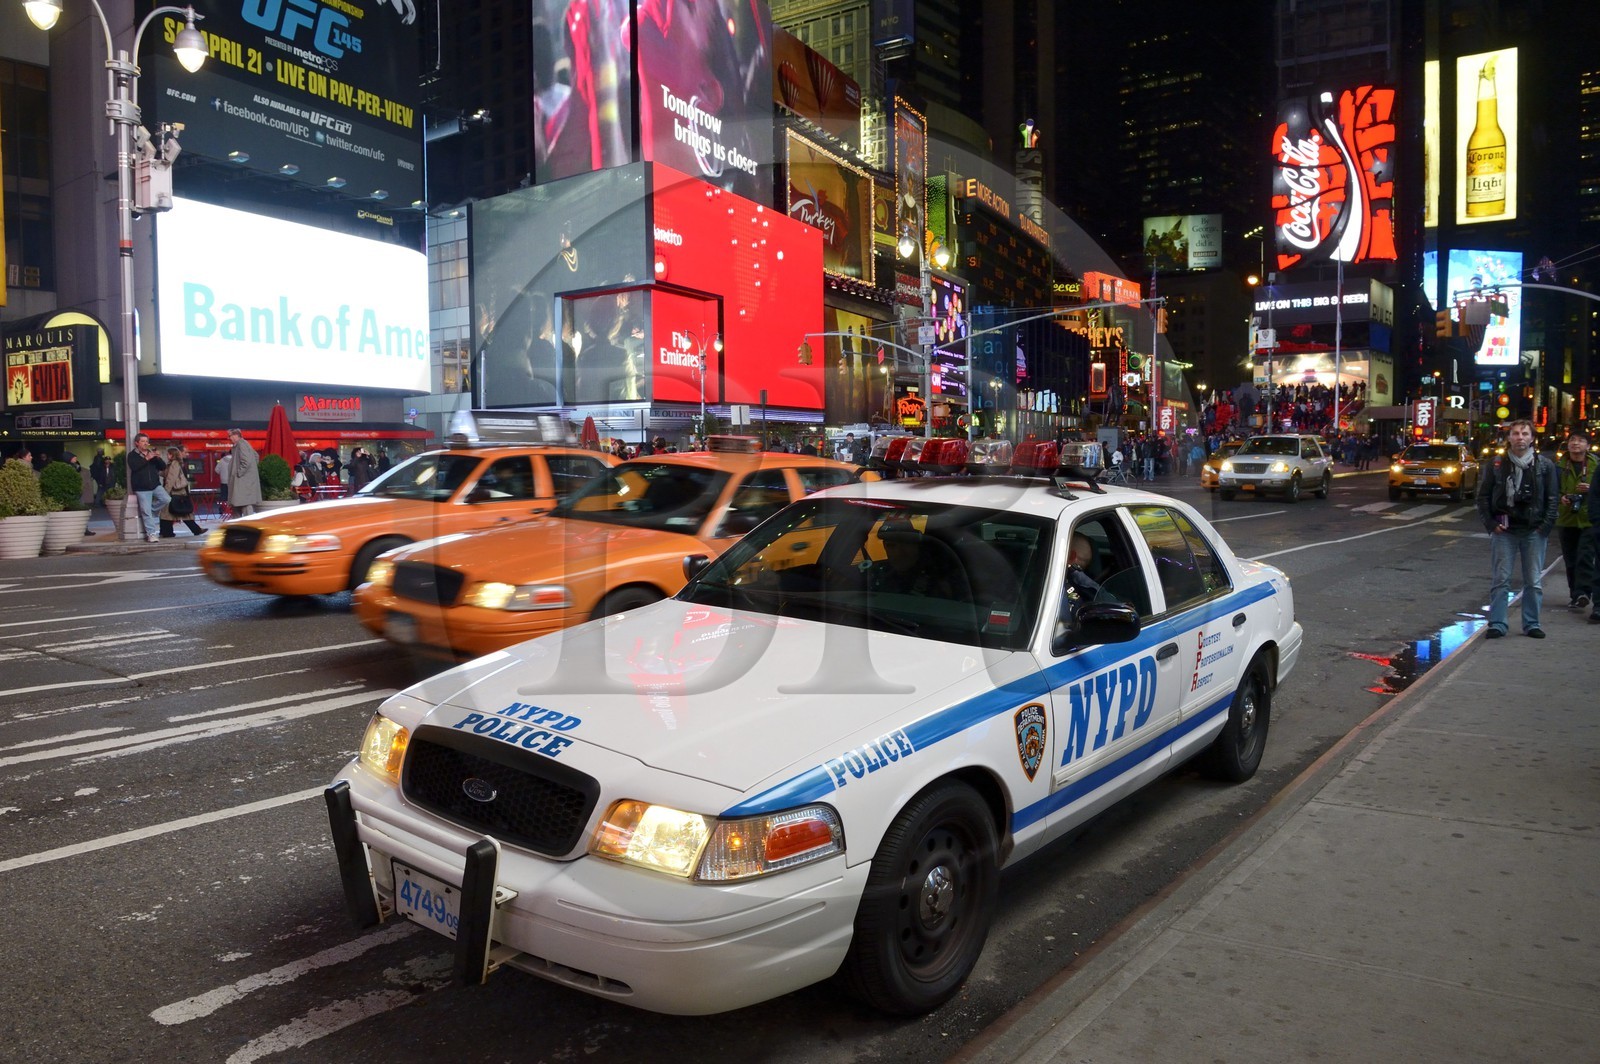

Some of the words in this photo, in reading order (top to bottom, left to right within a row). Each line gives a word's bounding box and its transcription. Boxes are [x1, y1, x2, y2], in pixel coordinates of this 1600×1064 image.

[241, 0, 349, 59] UFC
[333, 28, 362, 53] 145
[264, 36, 287, 52] PRESENTED
[287, 44, 293, 53] BY
[293, 46, 339, 71] metroPCS
[200, 29, 245, 70] APRIL
[247, 47, 262, 75] 21
[276, 58, 305, 91] LIVE
[308, 70, 327, 99] ON
[329, 78, 414, 129] PAY-PER-VIEW
[166, 88, 197, 104] UFC.COM
[253, 94, 269, 106] ALSO
[269, 99, 301, 117] AVAILABLE
[301, 109, 310, 120] ON
[660, 84, 722, 135] Tomorrow
[223, 100, 310, 138] facebook.com/UFC
[326, 133, 385, 161] twitter.com/ufc
[674, 118, 711, 158] brings
[713, 142, 726, 162] us
[727, 147, 758, 176] closer
[1468, 151, 1505, 164] Corona
[1281, 134, 1321, 251] Coca-Cola
[1471, 176, 1502, 191] Light
[790, 198, 836, 246] Turkey
[1276, 299, 1290, 309] ON
[1292, 297, 1312, 308] THIS
[1313, 296, 1330, 307] BIG
[1330, 293, 1369, 305] SREEN
[183, 281, 303, 348] Bank
[311, 304, 352, 350] of
[6, 328, 74, 349] MARQUIS
[660, 347, 700, 369] Emirates
[32, 361, 70, 403] EVITA
[298, 395, 361, 413] Marriott
[1418, 401, 1431, 427] tkts
[1161, 407, 1172, 430] tkts
[1190, 672, 1214, 693] RESPECT
[496, 702, 582, 731] NYPD
[1017, 714, 1045, 735] DEPARTMENT
[1021, 706, 1038, 720] POLICE
[1060, 654, 1158, 768] NYPD
[452, 712, 574, 759] POLICE
[824, 729, 914, 789] POLICE
[400, 879, 446, 924] 4749
